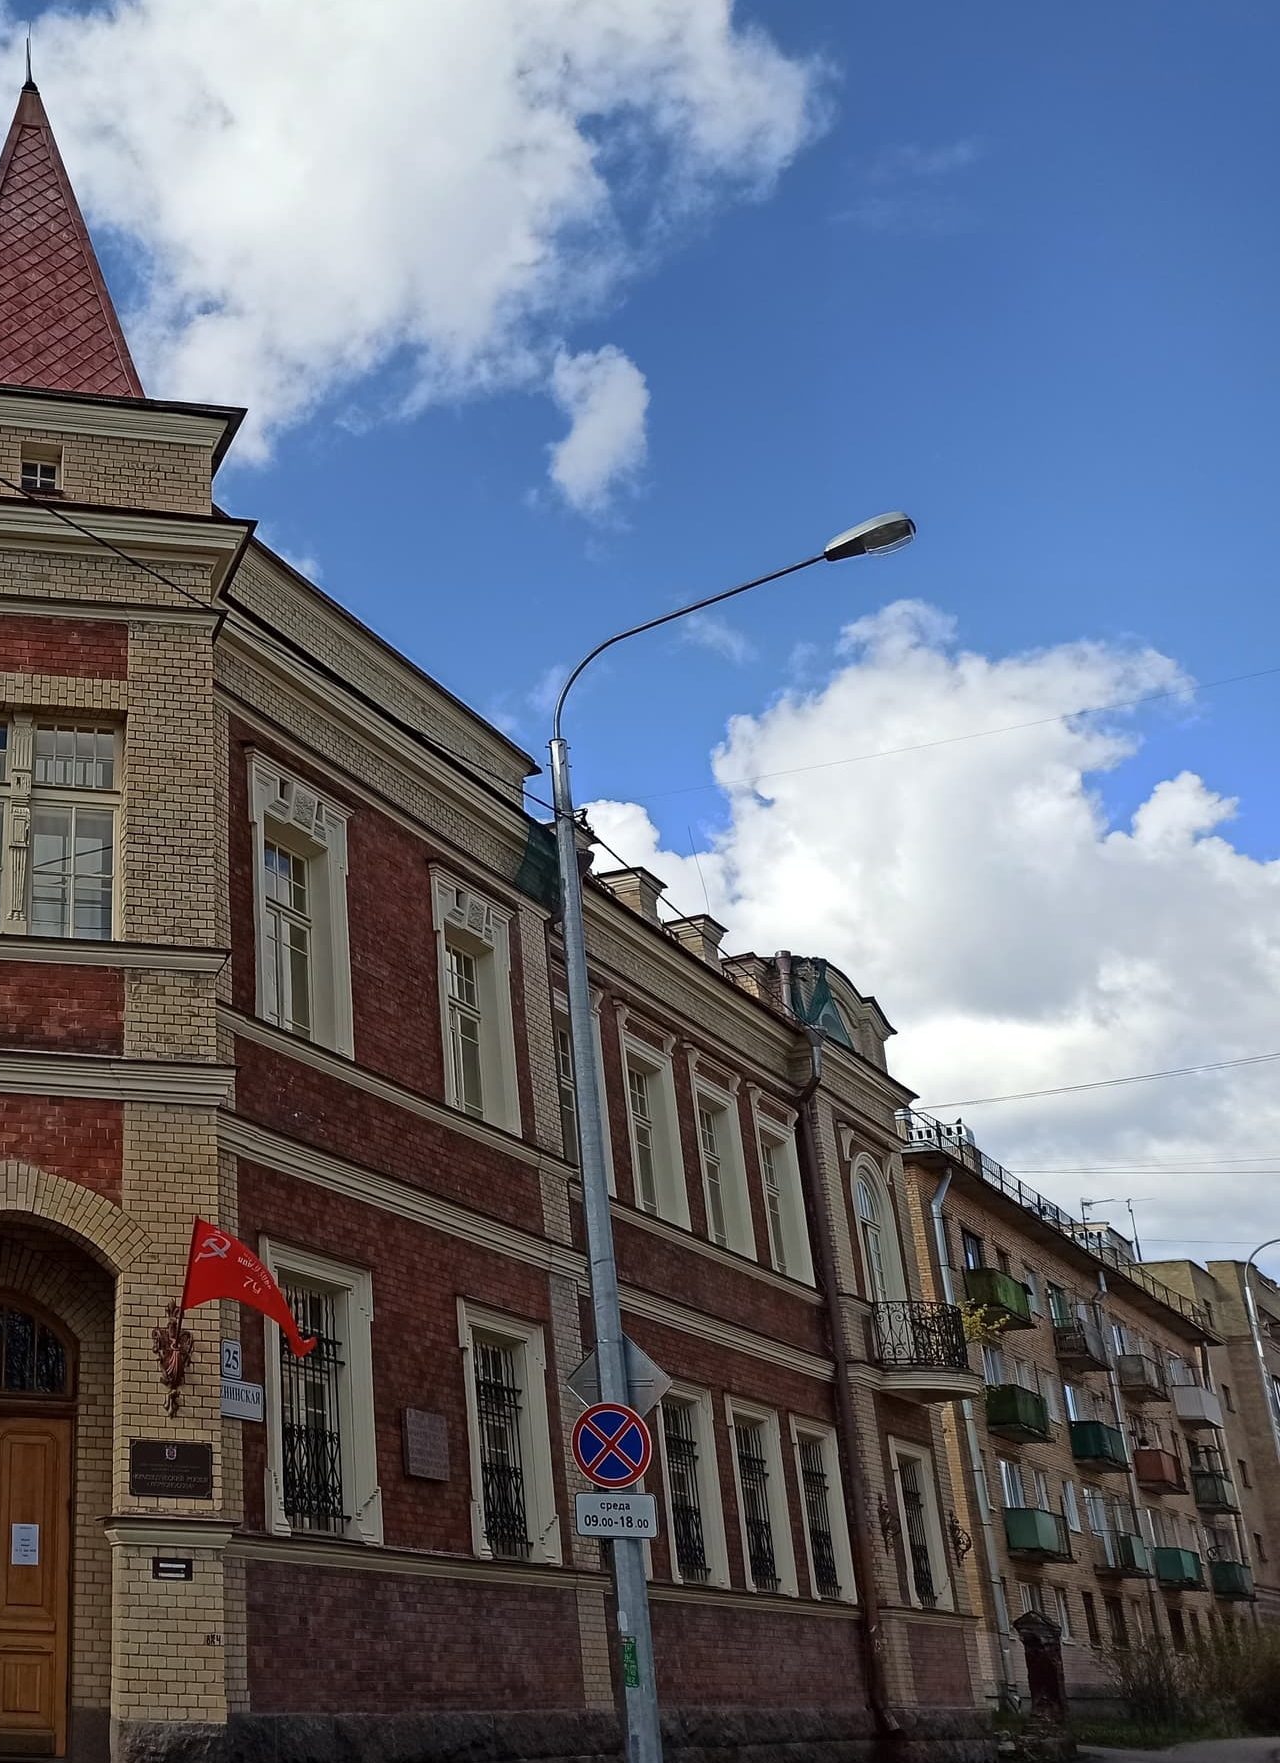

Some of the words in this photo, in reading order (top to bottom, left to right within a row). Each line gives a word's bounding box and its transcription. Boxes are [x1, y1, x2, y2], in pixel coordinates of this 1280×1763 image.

[224, 1348, 239, 1370] 25
[599, 1502, 631, 1512] среда
[584, 1514, 649, 1529] 09.00-18.00
